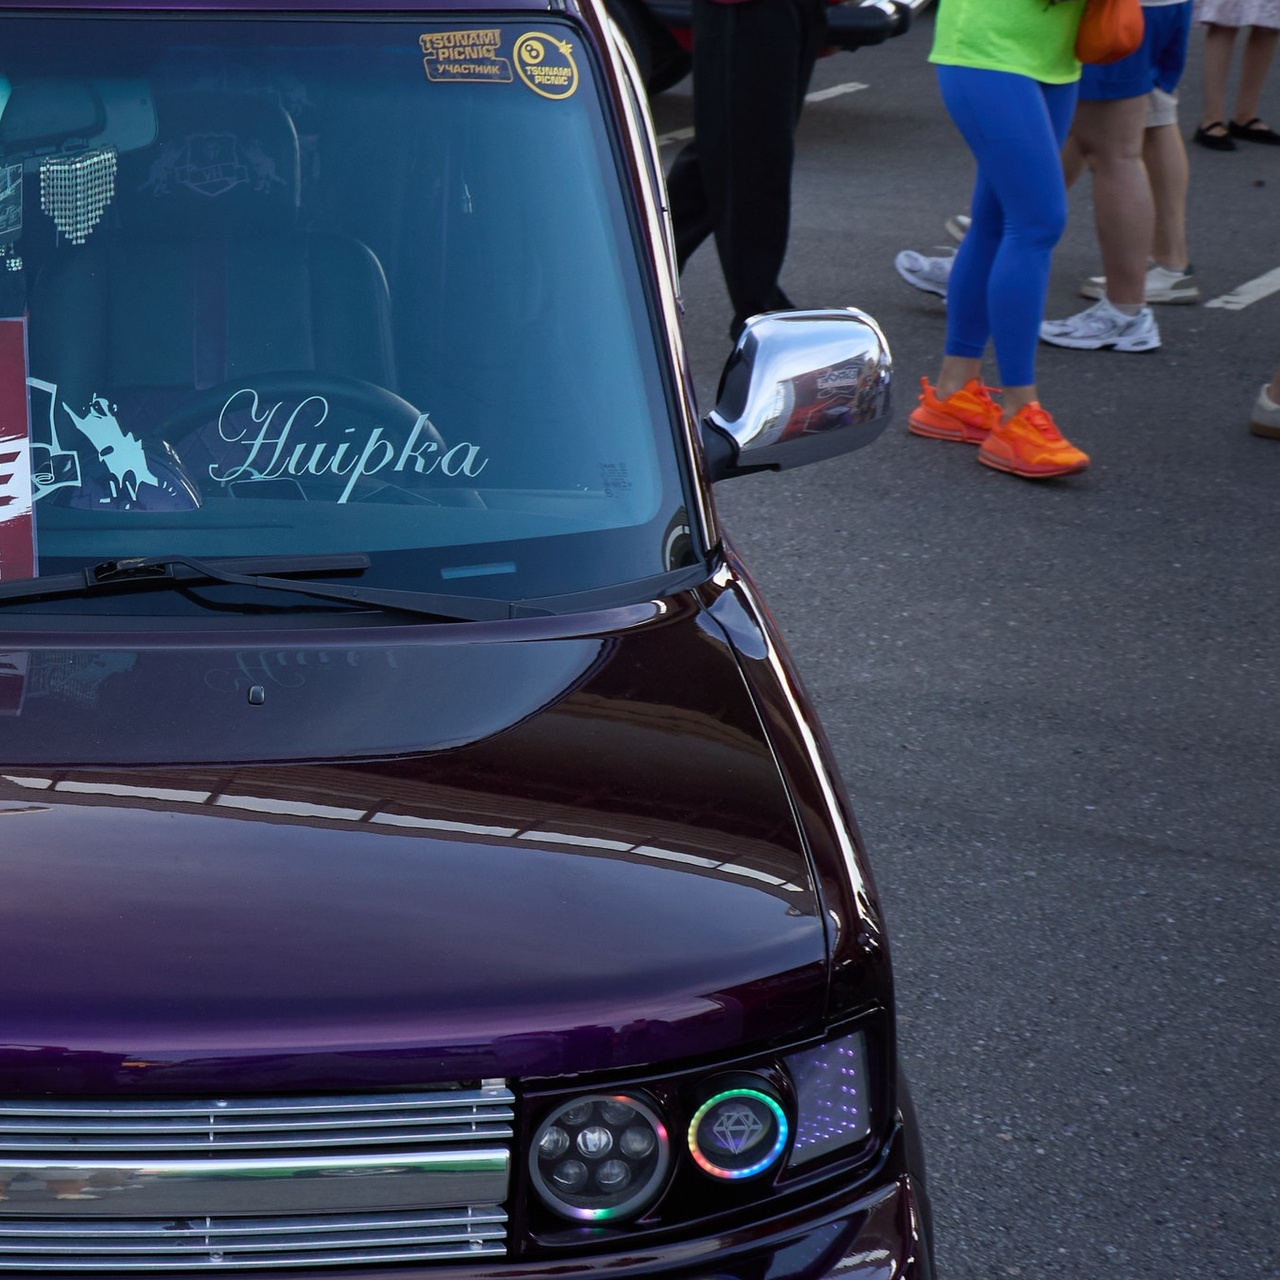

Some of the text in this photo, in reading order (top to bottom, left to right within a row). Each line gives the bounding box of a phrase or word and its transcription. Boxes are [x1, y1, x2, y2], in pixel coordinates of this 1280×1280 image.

[421, 30, 500, 49] TSUNAMI
[438, 46, 496, 61] PICNIC
[437, 64, 500, 75] УЧАСТНИК
[525, 66, 572, 77] TSUNAMI
[534, 75, 569, 85] PICNIC
[209, 388, 489, 504] Huipka
